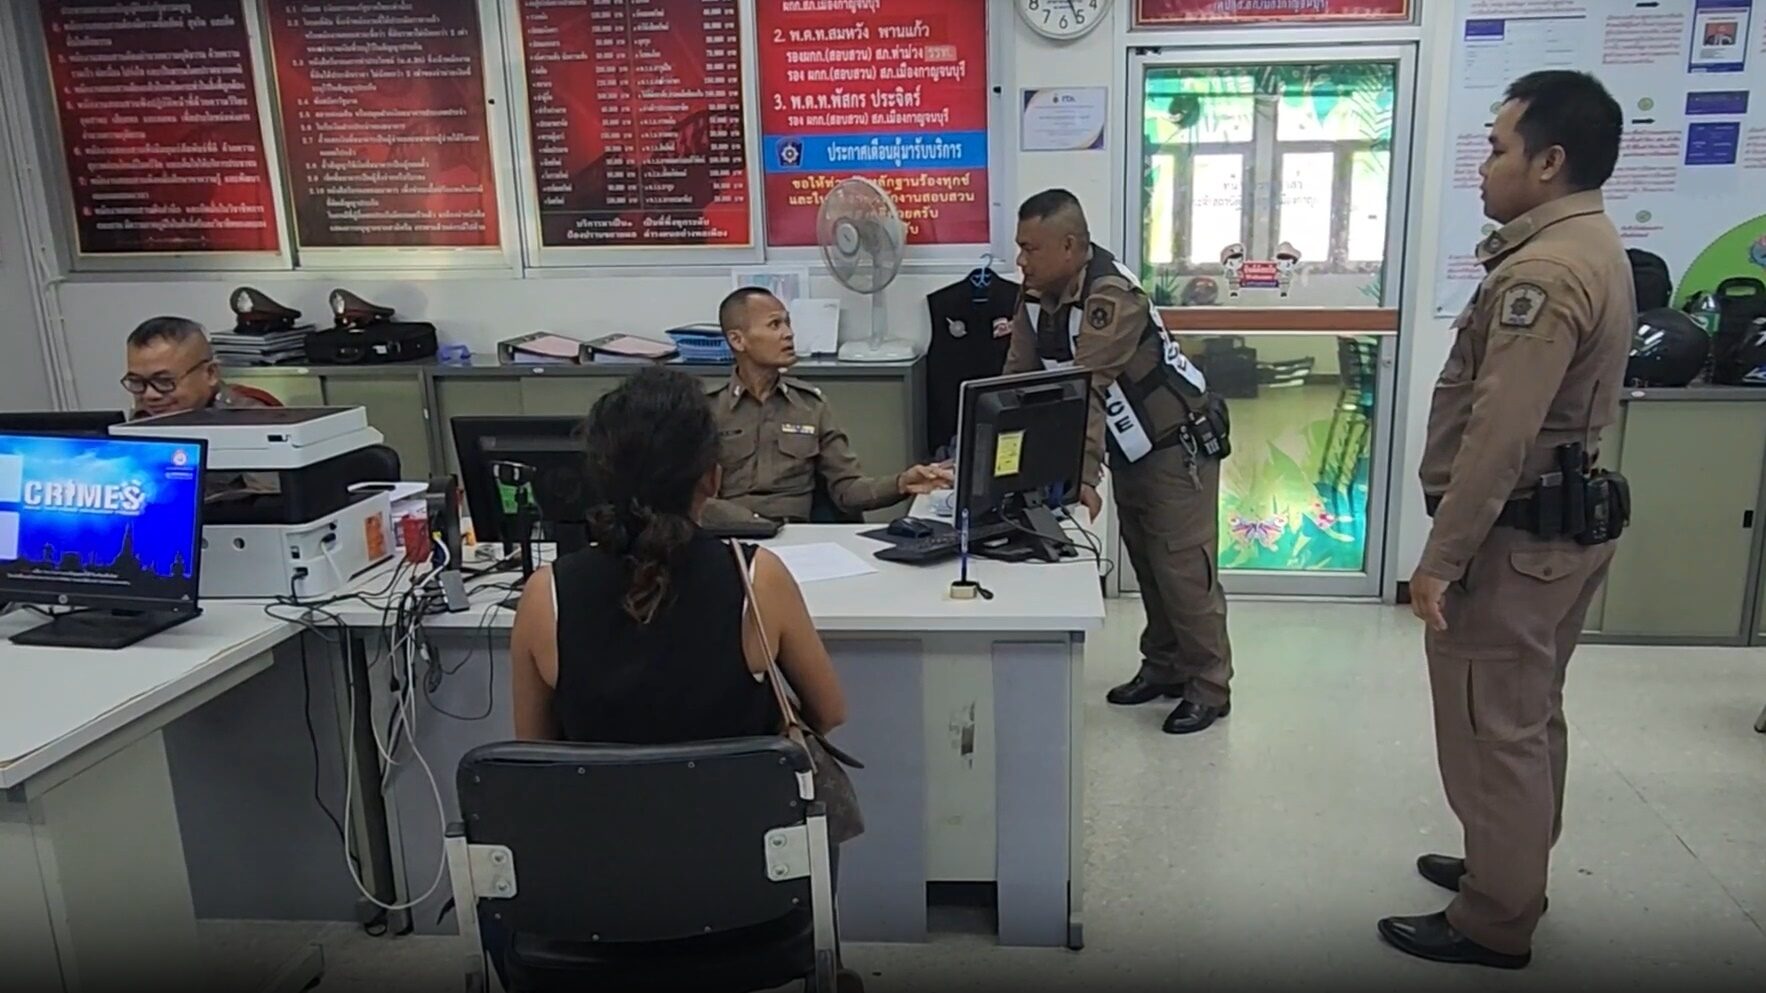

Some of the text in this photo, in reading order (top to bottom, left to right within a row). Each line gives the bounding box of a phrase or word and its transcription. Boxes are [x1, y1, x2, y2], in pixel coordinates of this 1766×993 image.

[1042, 9, 1051, 24] 7
[1059, 15, 1069, 29] 6
[24, 480, 143, 512] CRIMES
